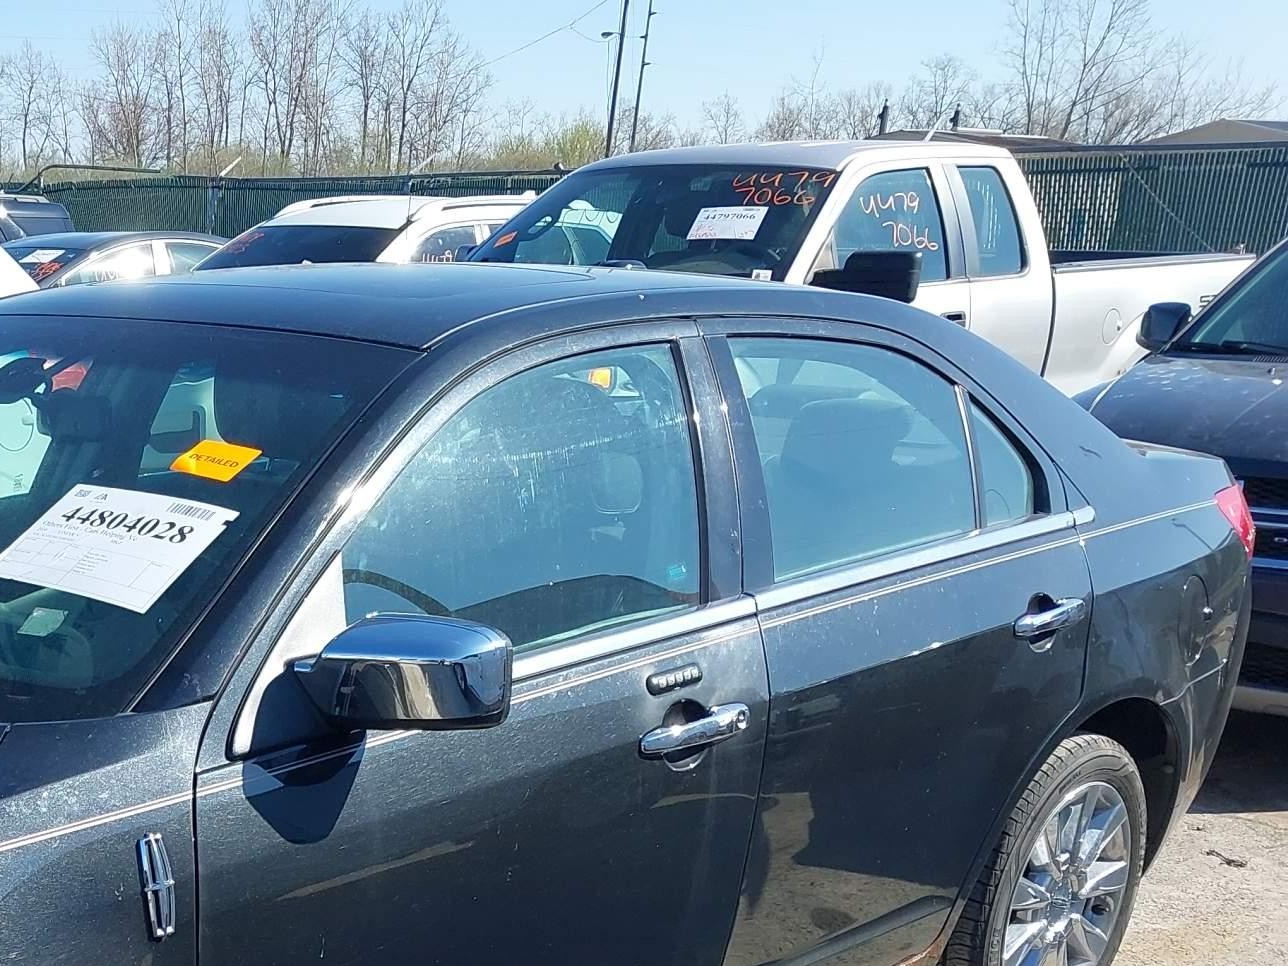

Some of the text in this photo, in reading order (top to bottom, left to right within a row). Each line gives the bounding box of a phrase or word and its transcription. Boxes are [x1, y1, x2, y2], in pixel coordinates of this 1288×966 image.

[732, 171, 836, 188] 4479
[735, 187, 816, 206] 7066
[859, 191, 920, 218] 4479
[882, 221, 940, 251] 7066
[188, 453, 240, 468] DETAILED
[60, 506, 195, 544] 44804028
